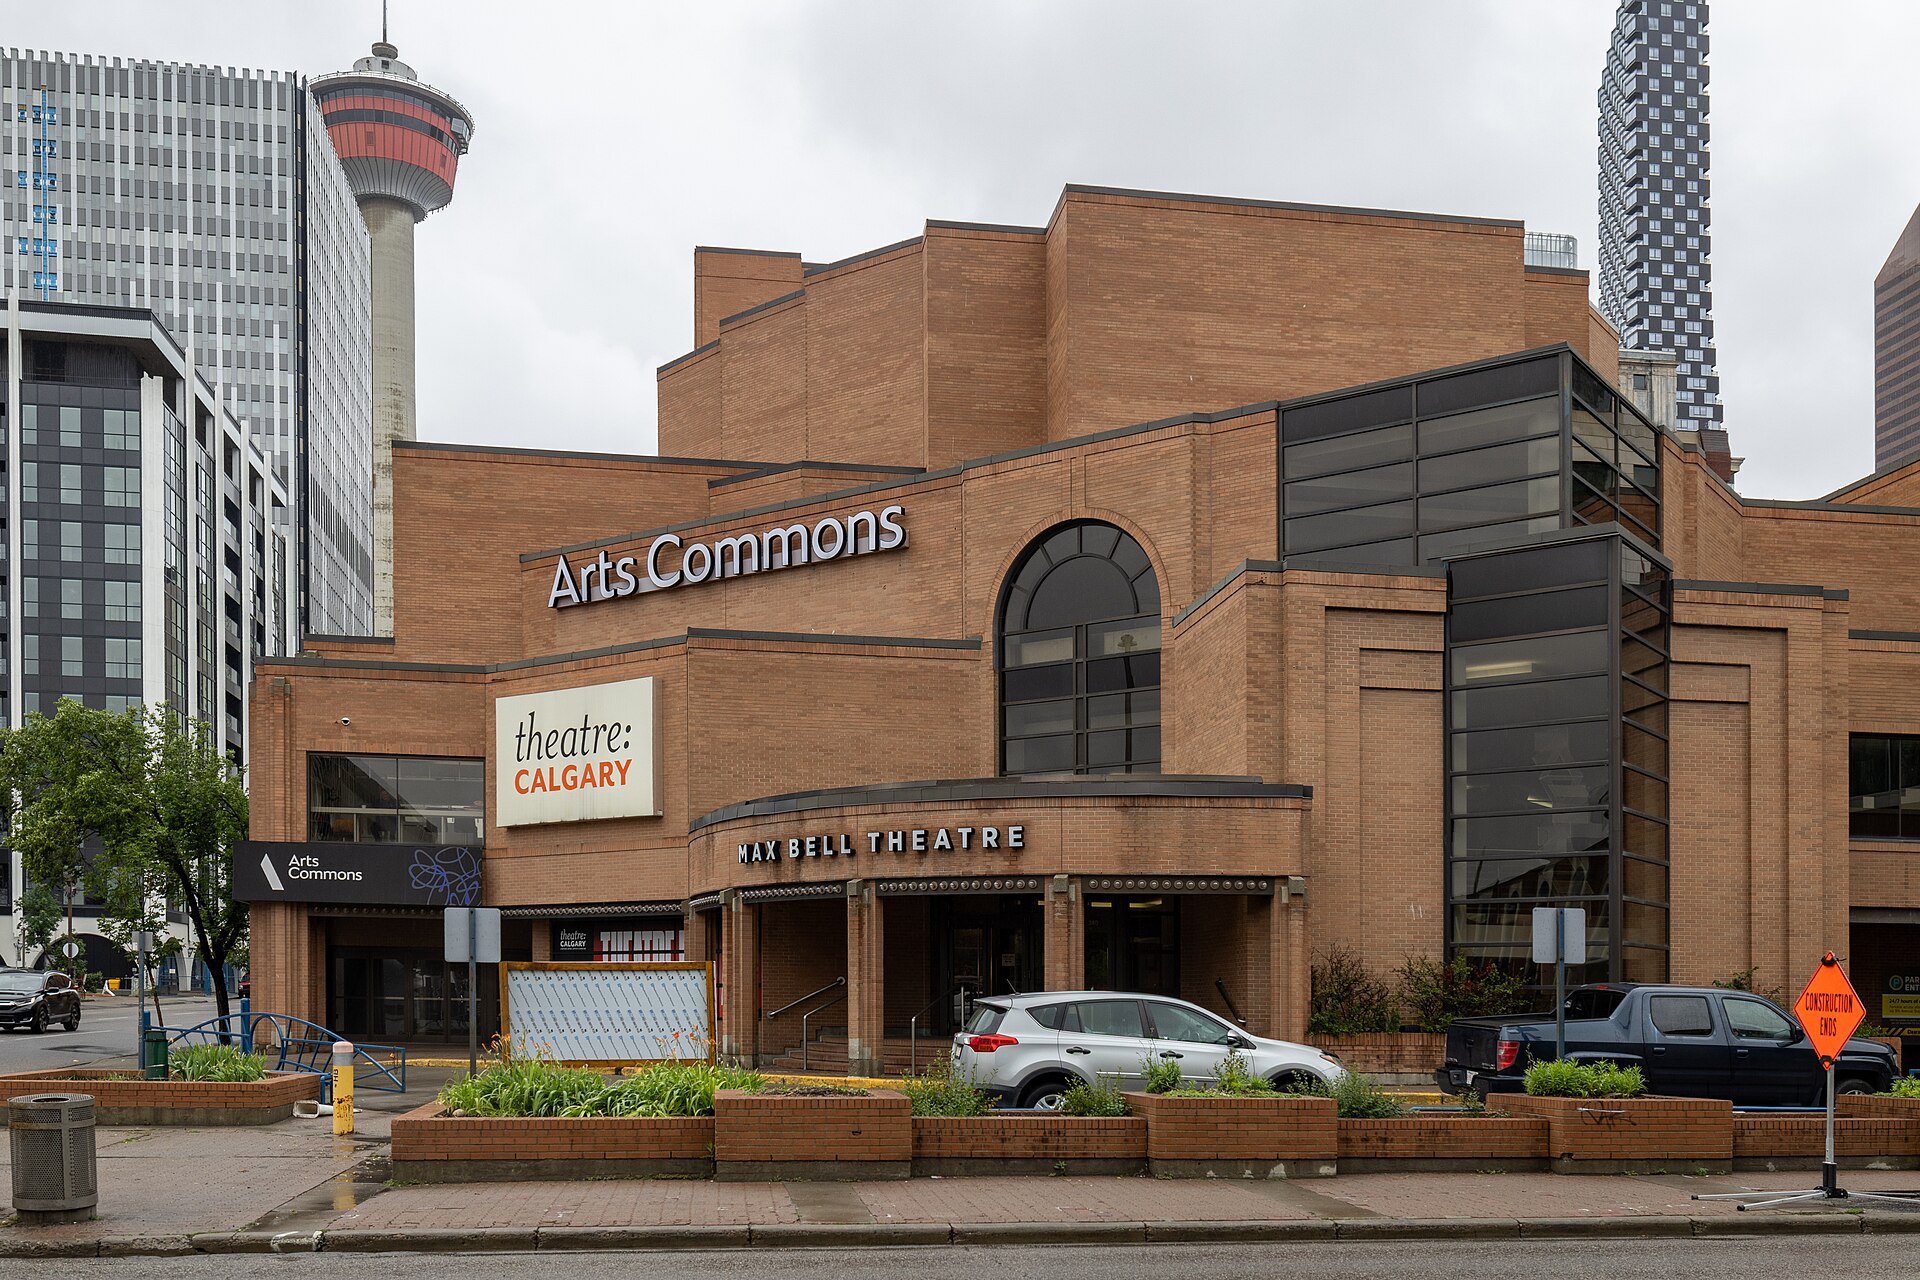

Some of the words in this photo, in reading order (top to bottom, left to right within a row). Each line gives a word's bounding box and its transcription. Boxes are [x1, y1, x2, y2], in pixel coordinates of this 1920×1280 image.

[547, 550, 639, 608] Arts
[647, 505, 906, 588] Commons
[515, 710, 632, 763] theatre:
[514, 758, 633, 795] CALGARY
[738, 840, 779, 864] MAX
[788, 834, 854, 859] BELL
[867, 825, 1025, 853] THEATRE
[288, 854, 320, 867] Arts
[288, 866, 363, 881] Commons
[560, 940, 587, 948] CALGARY
[1805, 992, 1853, 1013] CONSTRUCTION
[1820, 1016, 1837, 1037] ENDS
